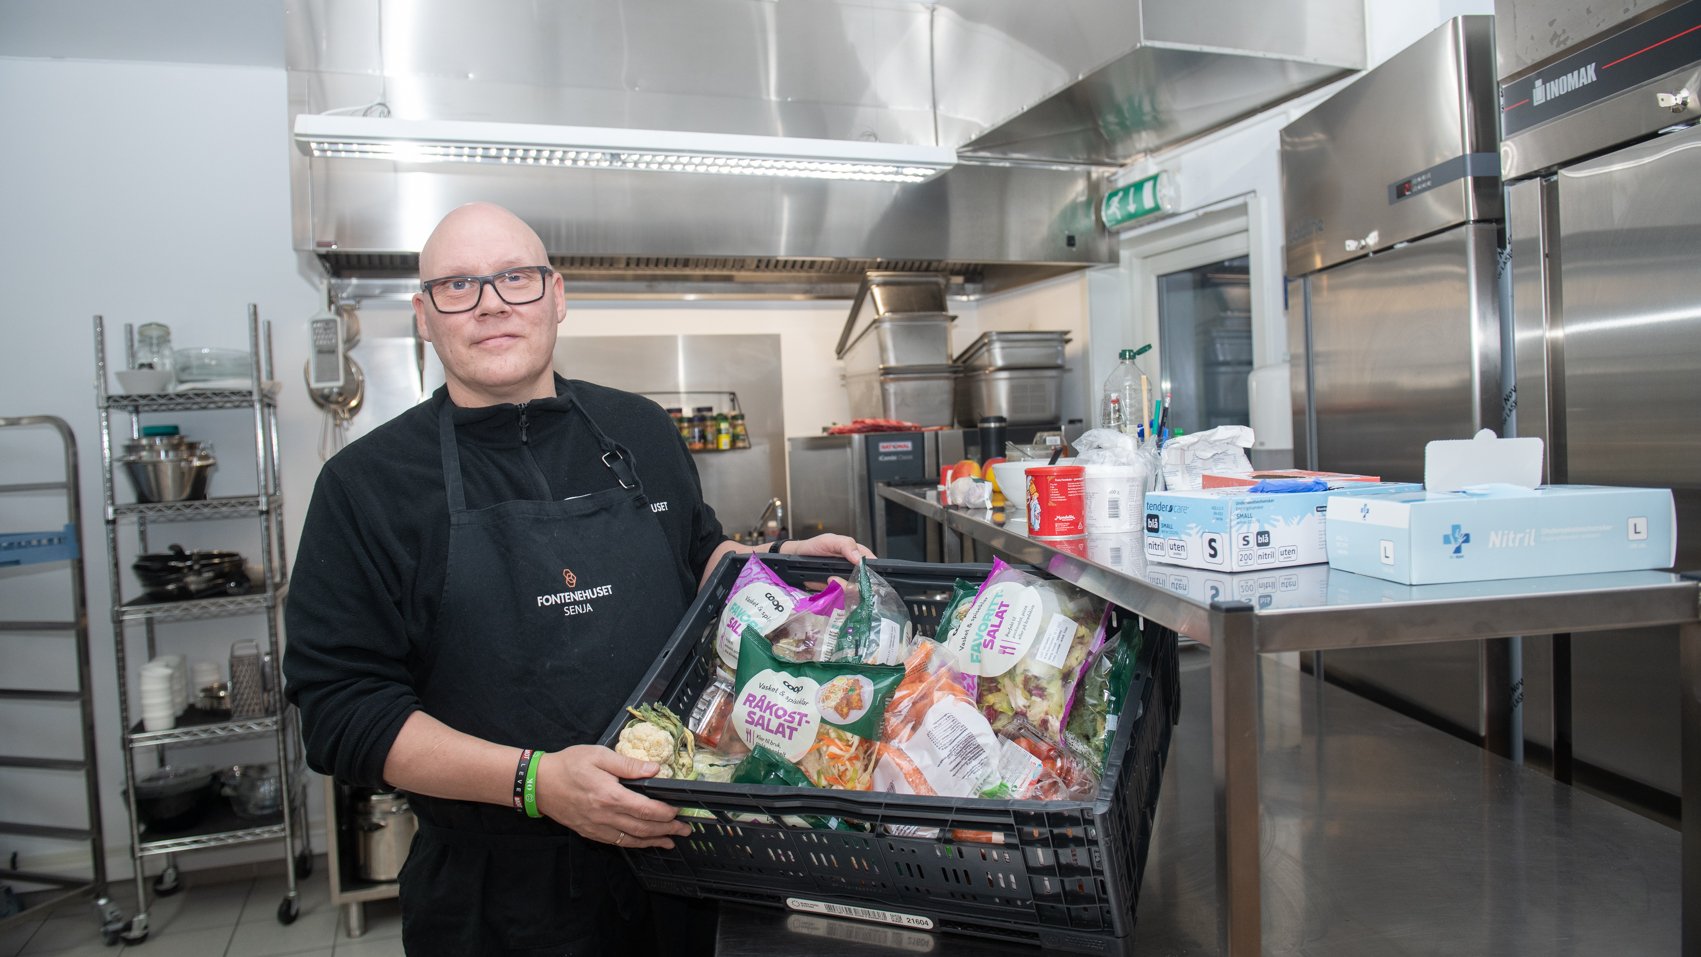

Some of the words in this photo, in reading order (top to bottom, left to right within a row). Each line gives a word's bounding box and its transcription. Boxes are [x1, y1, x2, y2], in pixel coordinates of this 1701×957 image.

[1546, 62, 1597, 101] INOMAK
[1146, 502, 1168, 512] tender
[1147, 518, 1159, 529] blå
[1634, 523, 1641, 534] L
[1242, 535, 1250, 546] S
[1257, 533, 1269, 544] blå
[1488, 529, 1536, 548] Nitril
[1148, 541, 1164, 551] nitril
[1169, 543, 1186, 552] uten
[1208, 538, 1218, 558] S
[1384, 546, 1390, 559] L
[1239, 553, 1253, 562] 200
[1257, 552, 1275, 560] nitril
[537, 585, 613, 607] FONTENEHUSET
[764, 592, 785, 613] coop
[563, 603, 594, 616] SENJA
[970, 590, 1004, 664] FAVORITT-
[983, 601, 1010, 650] SALAT
[959, 628, 969, 651] Vasket
[783, 680, 804, 693] coop
[758, 682, 778, 694] Vasket
[785, 695, 809, 706] spiseklar
[742, 692, 811, 727] RÅKOST-
[744, 710, 798, 740] SALAT
[527, 778, 533, 791] OK
[906, 917, 929, 927] 21604
